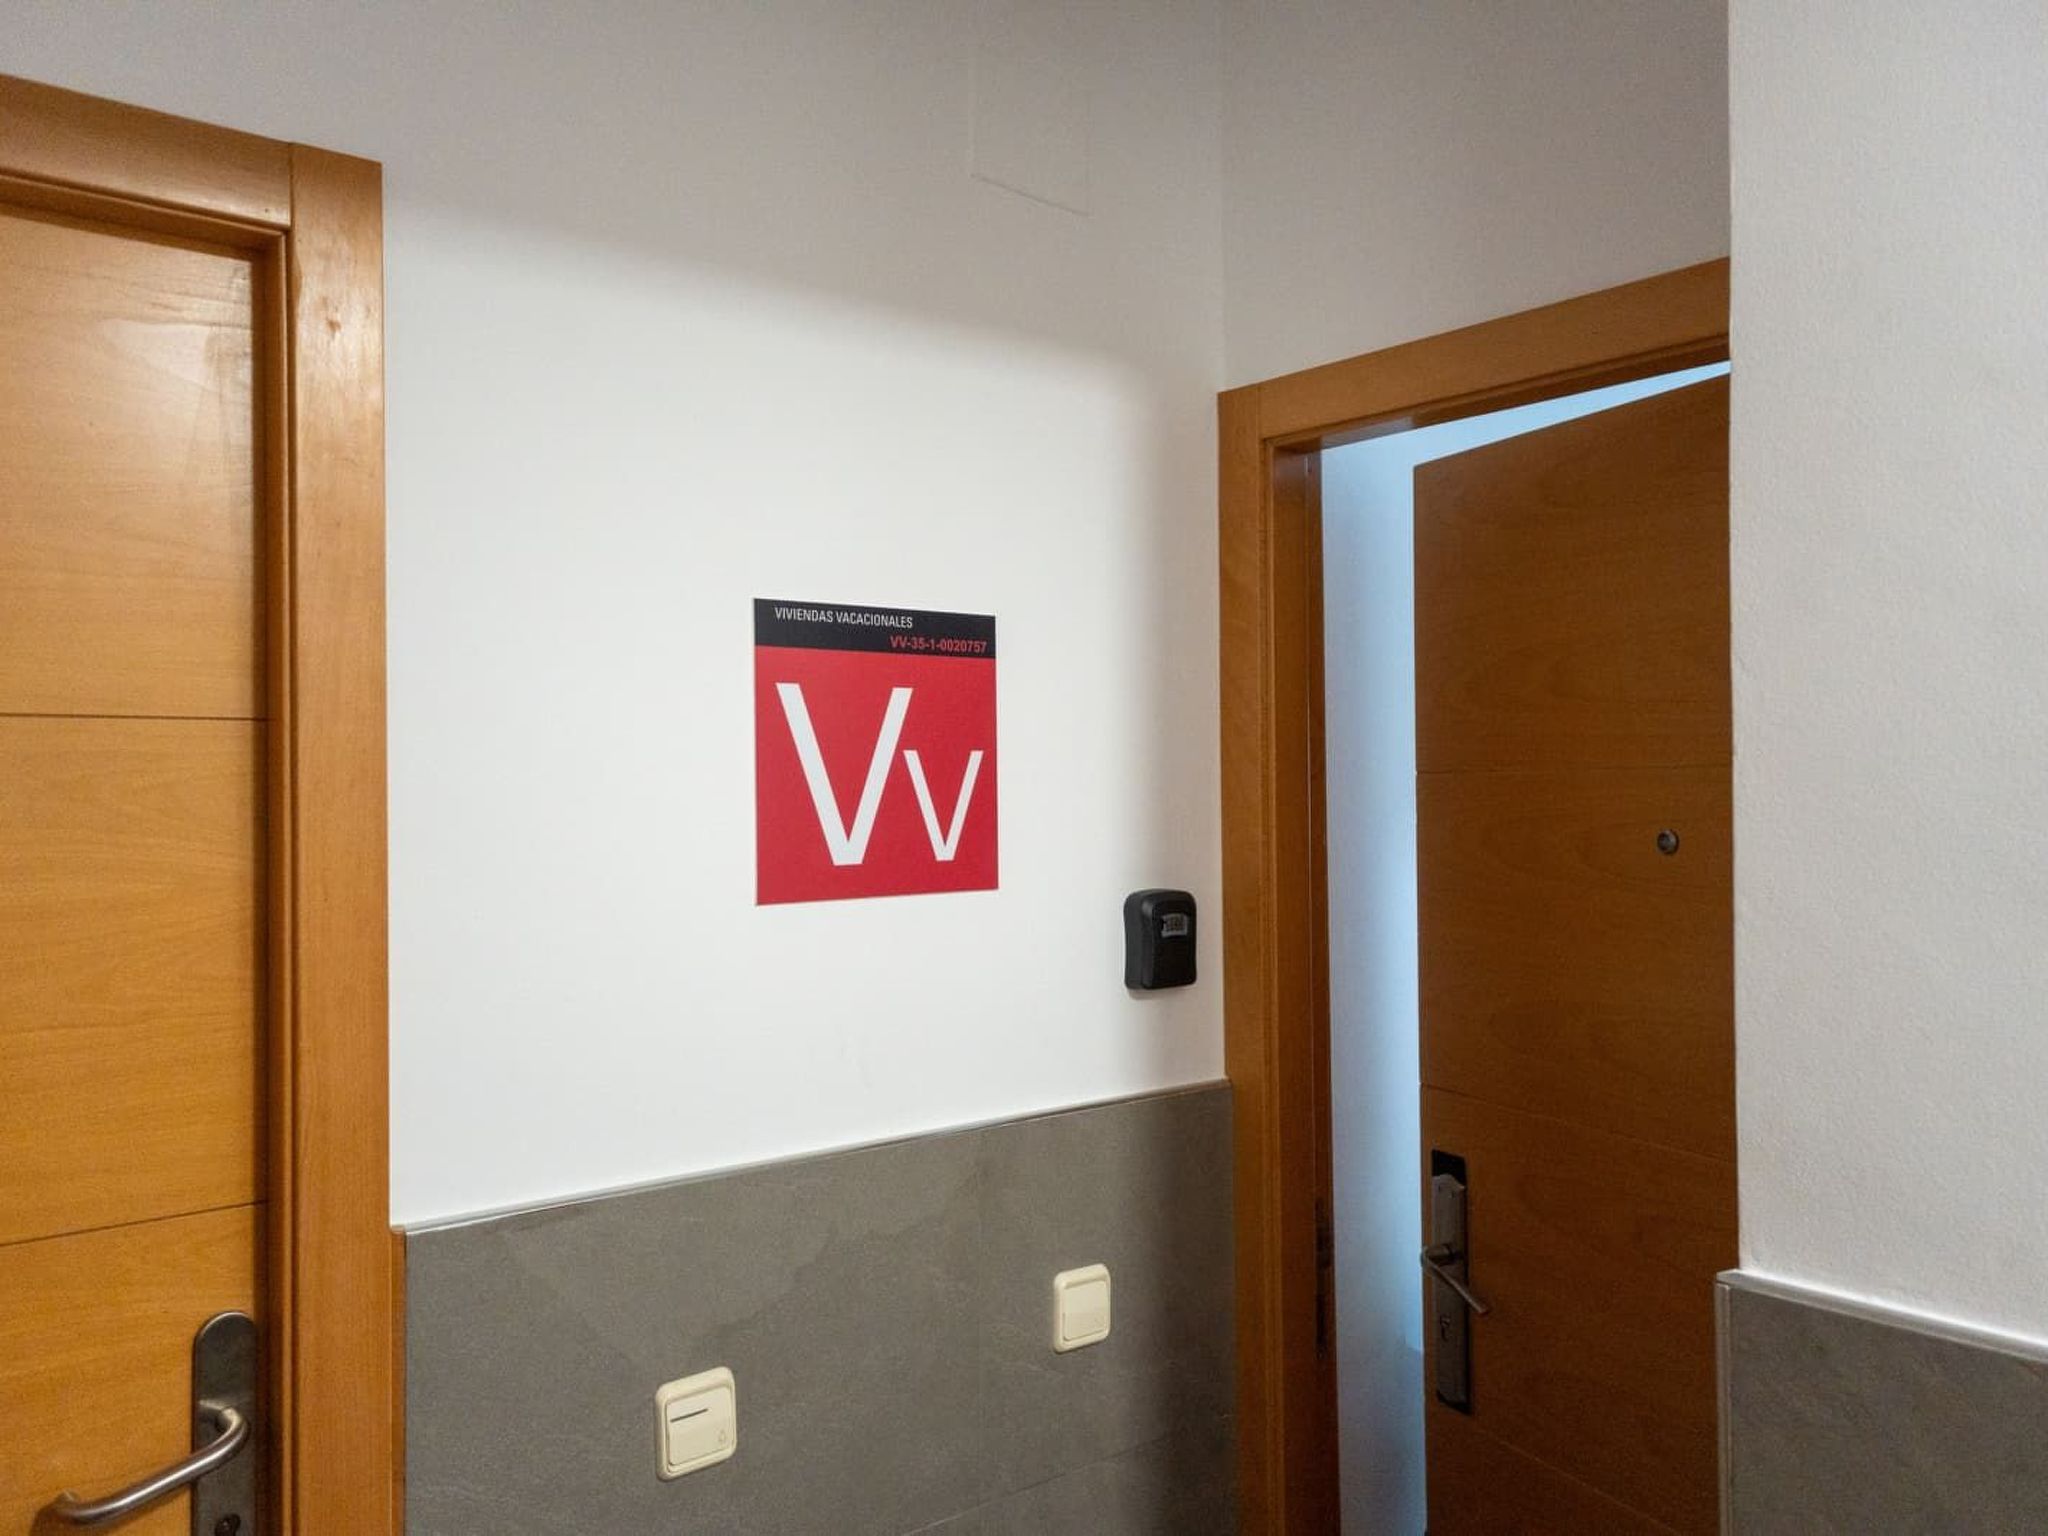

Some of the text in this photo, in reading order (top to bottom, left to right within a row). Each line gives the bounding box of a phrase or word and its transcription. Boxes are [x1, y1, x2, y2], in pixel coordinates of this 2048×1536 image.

[774, 606, 913, 629] VIVIENDAS VACACIONALES
[890, 635, 988, 654] VV-35-1-0020757
